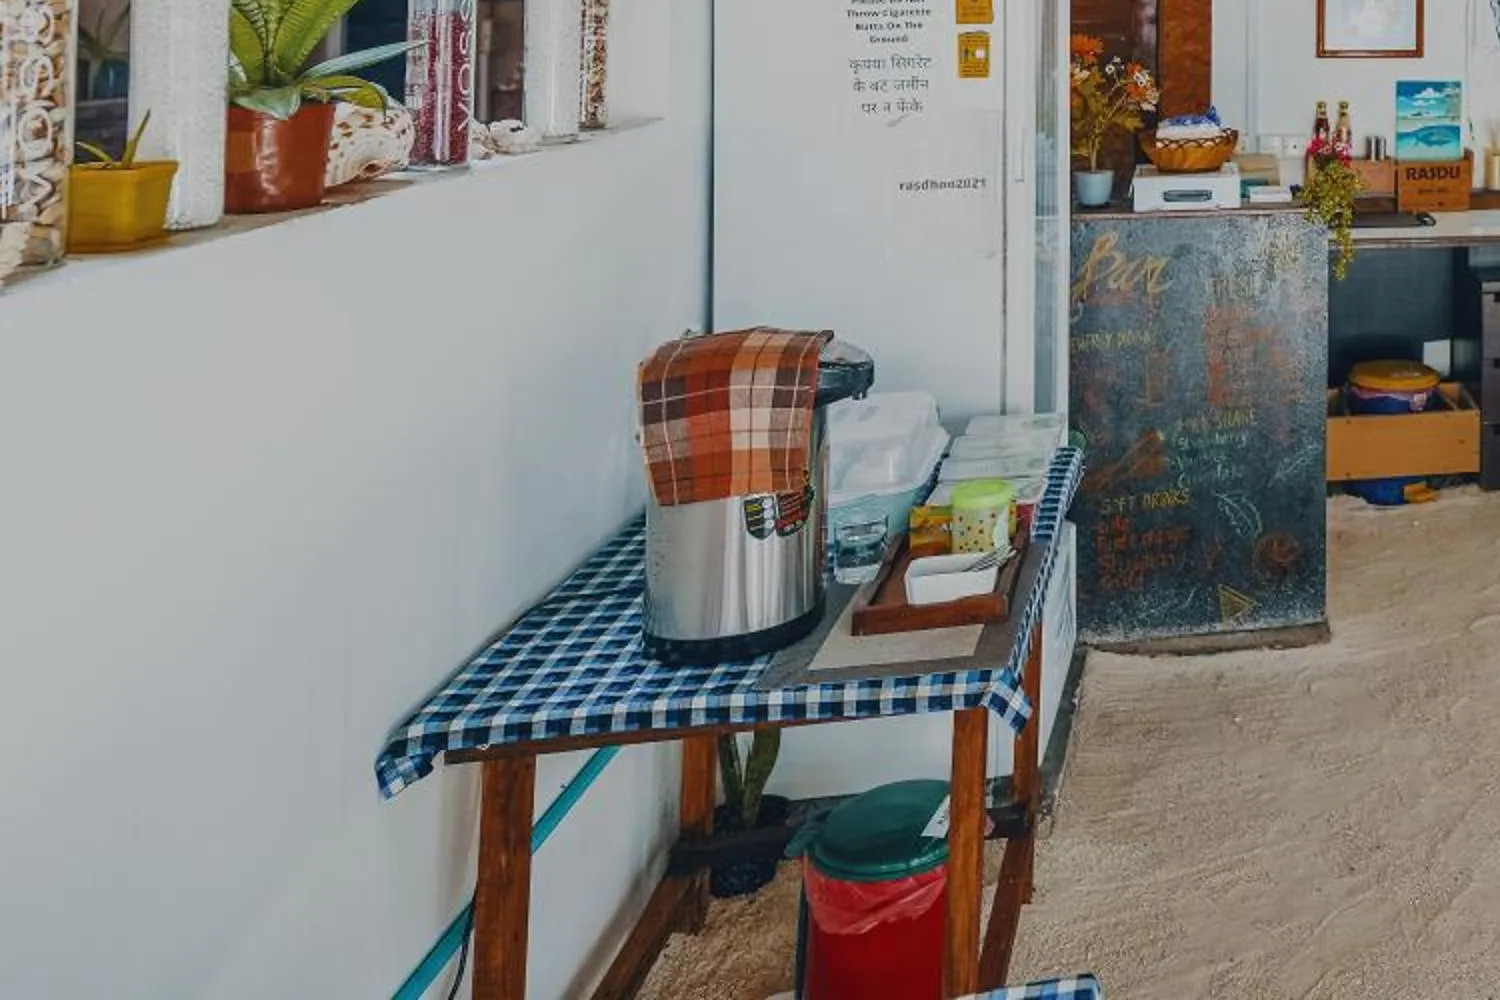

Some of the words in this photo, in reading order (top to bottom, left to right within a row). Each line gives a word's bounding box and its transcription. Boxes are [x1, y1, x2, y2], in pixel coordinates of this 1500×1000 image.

[847, 9, 879, 17] Throw
[882, 9, 931, 18] Cigarette
[905, 21, 923, 29] The
[869, 34, 909, 43] Ground
